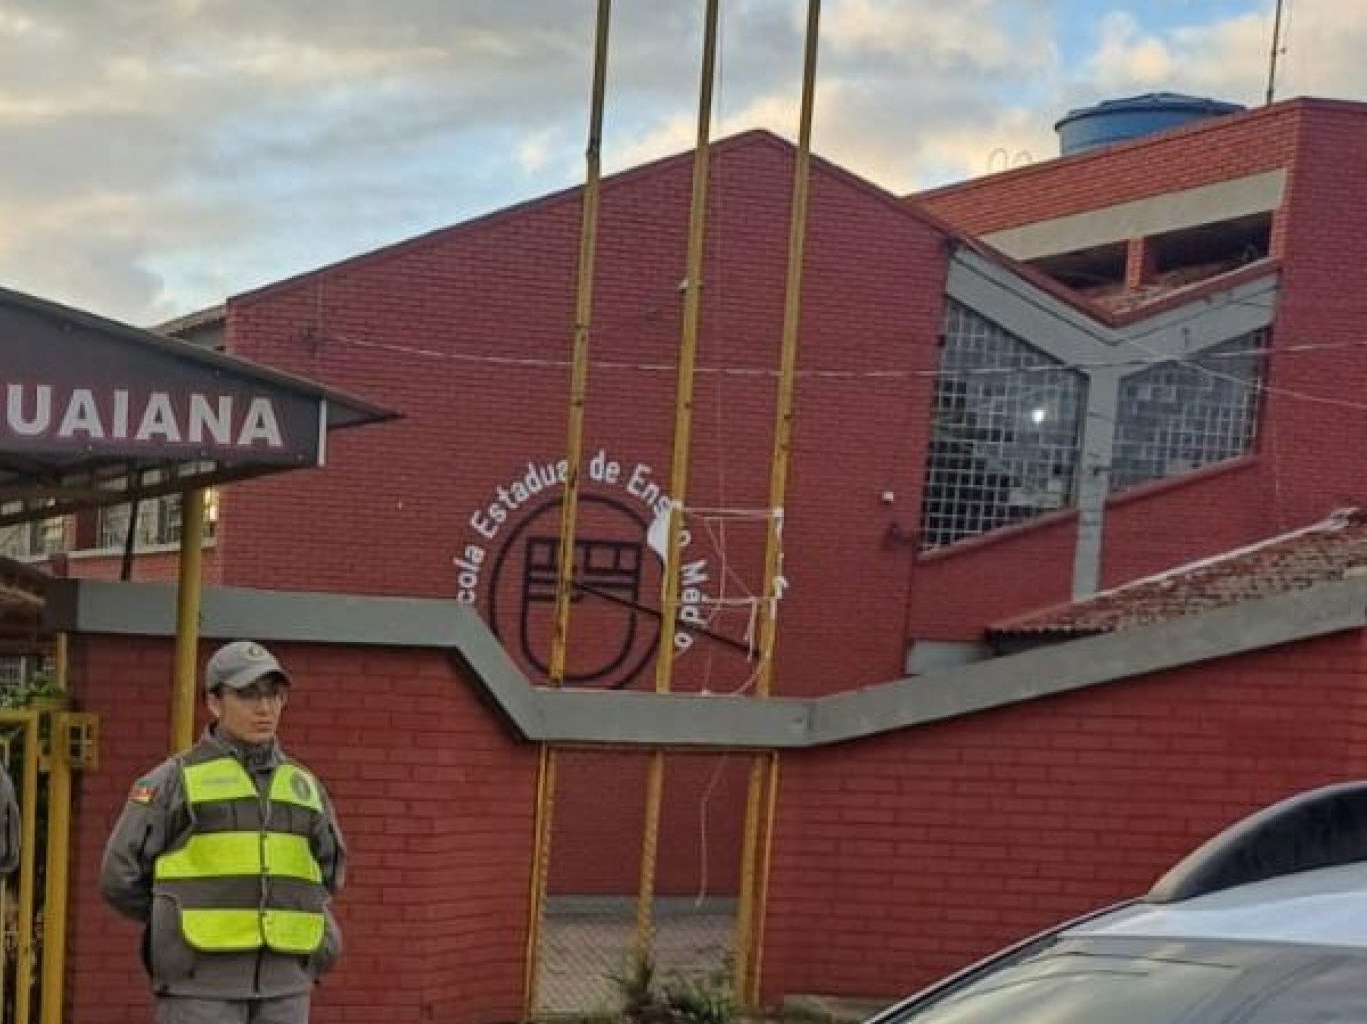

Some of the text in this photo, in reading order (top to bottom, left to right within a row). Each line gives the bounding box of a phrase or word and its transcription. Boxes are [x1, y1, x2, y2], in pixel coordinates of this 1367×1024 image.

[453, 545, 485, 604] cola
[469, 460, 570, 538] Estadua
[589, 449, 621, 484] de
